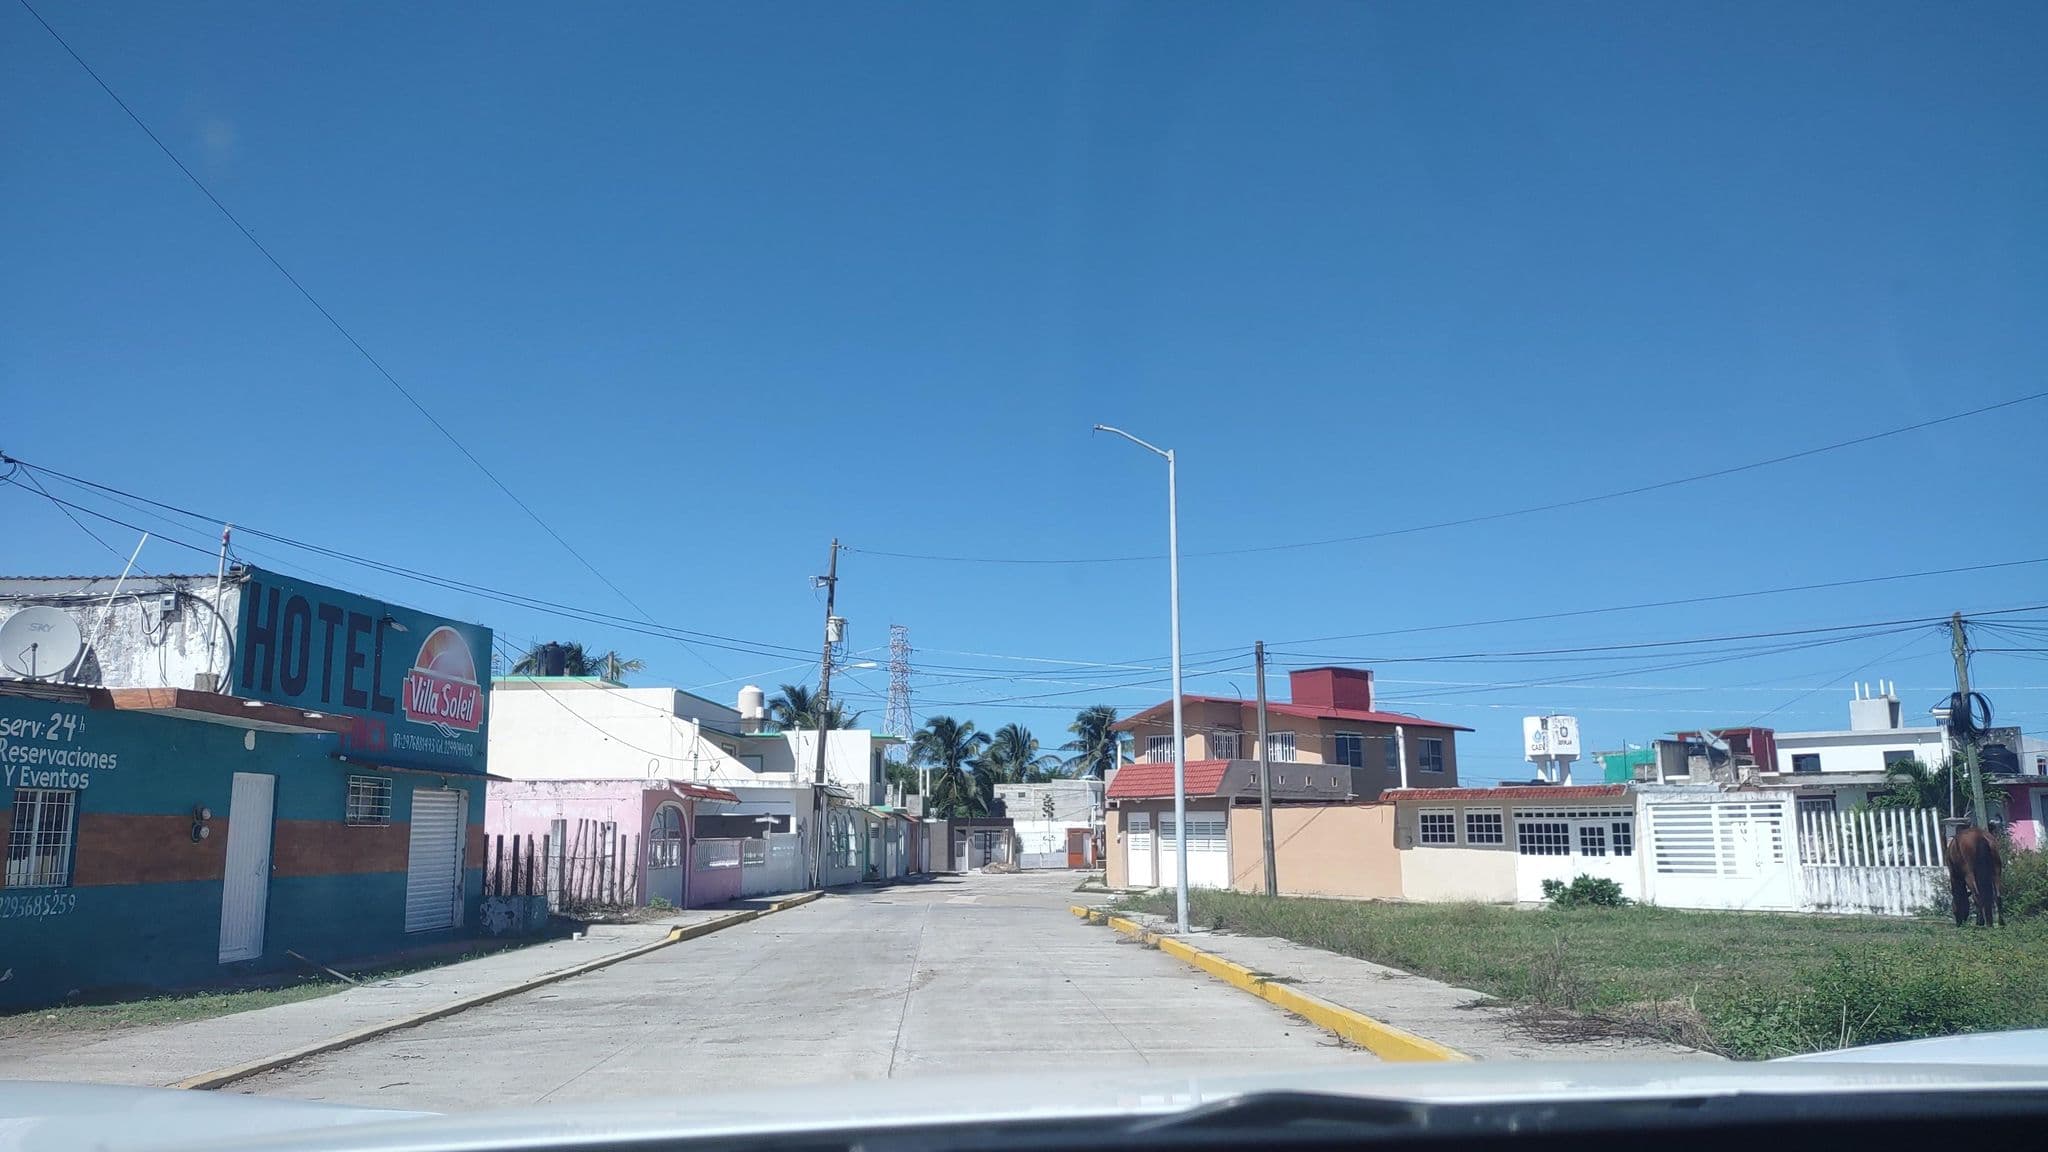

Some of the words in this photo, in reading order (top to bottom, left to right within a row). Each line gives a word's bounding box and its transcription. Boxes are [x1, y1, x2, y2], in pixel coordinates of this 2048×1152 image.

[242, 581, 395, 714] HOTEL
[410, 674, 439, 715] Villa
[441, 683, 476, 721] Soleil
[0, 738, 117, 769] Reservaciones
[4, 764, 17, 787] Y
[20, 765, 90, 790] Eventos
